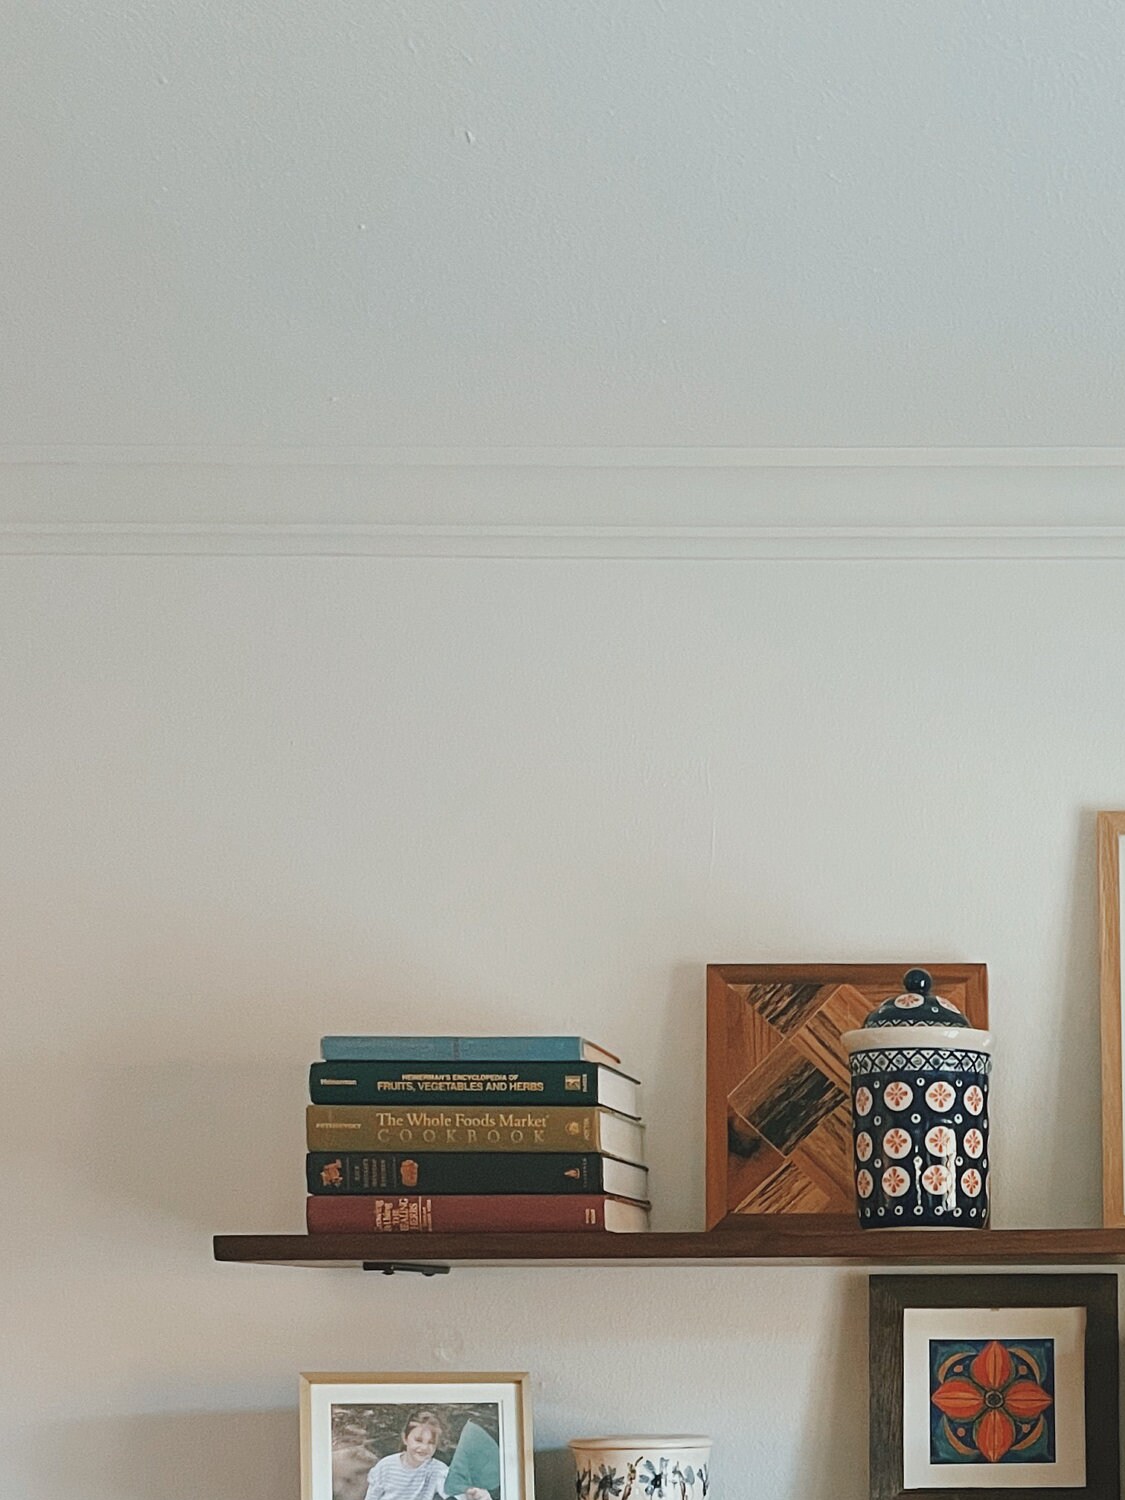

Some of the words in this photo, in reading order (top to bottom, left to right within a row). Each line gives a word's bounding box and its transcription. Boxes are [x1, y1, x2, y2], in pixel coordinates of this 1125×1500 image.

[509, 1073, 519, 1081] OF
[377, 1082, 416, 1091] FRUITS,
[418, 1081, 482, 1091] VEGETABLES
[485, 1081, 507, 1091] AND
[509, 1081, 544, 1091] HERBS
[376, 1113, 404, 1126] The
[406, 1113, 451, 1127] Whole
[455, 1113, 496, 1127] Foods
